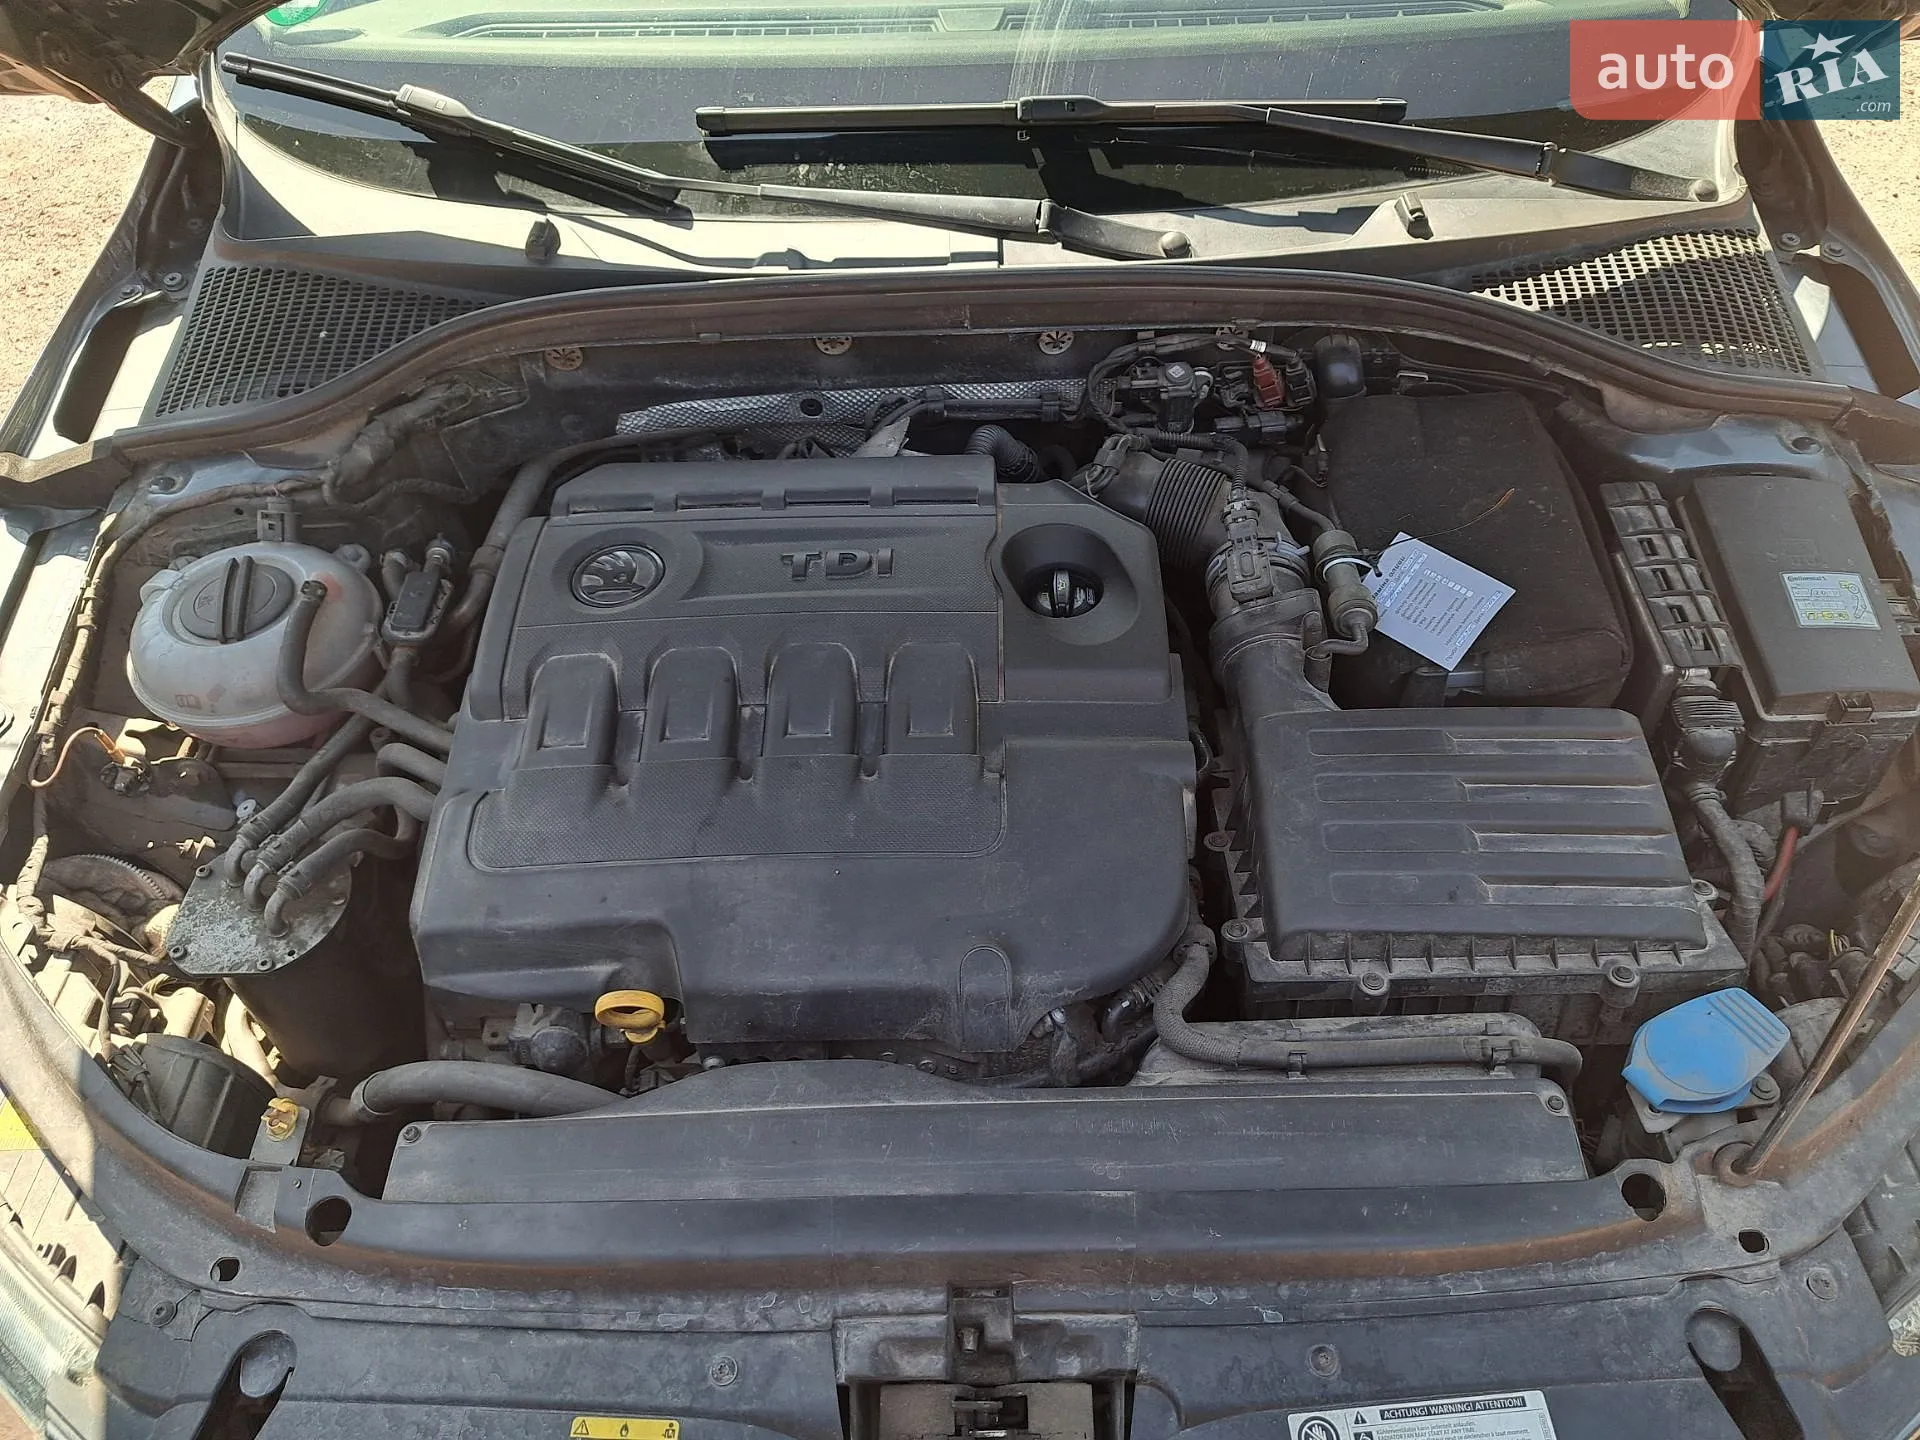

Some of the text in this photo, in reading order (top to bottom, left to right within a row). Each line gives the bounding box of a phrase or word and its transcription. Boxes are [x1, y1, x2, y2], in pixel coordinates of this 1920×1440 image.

[780, 547, 895, 581] TDI
[1383, 1398, 1523, 1420] ACHTUNG! WARNING! ATTENTION!
